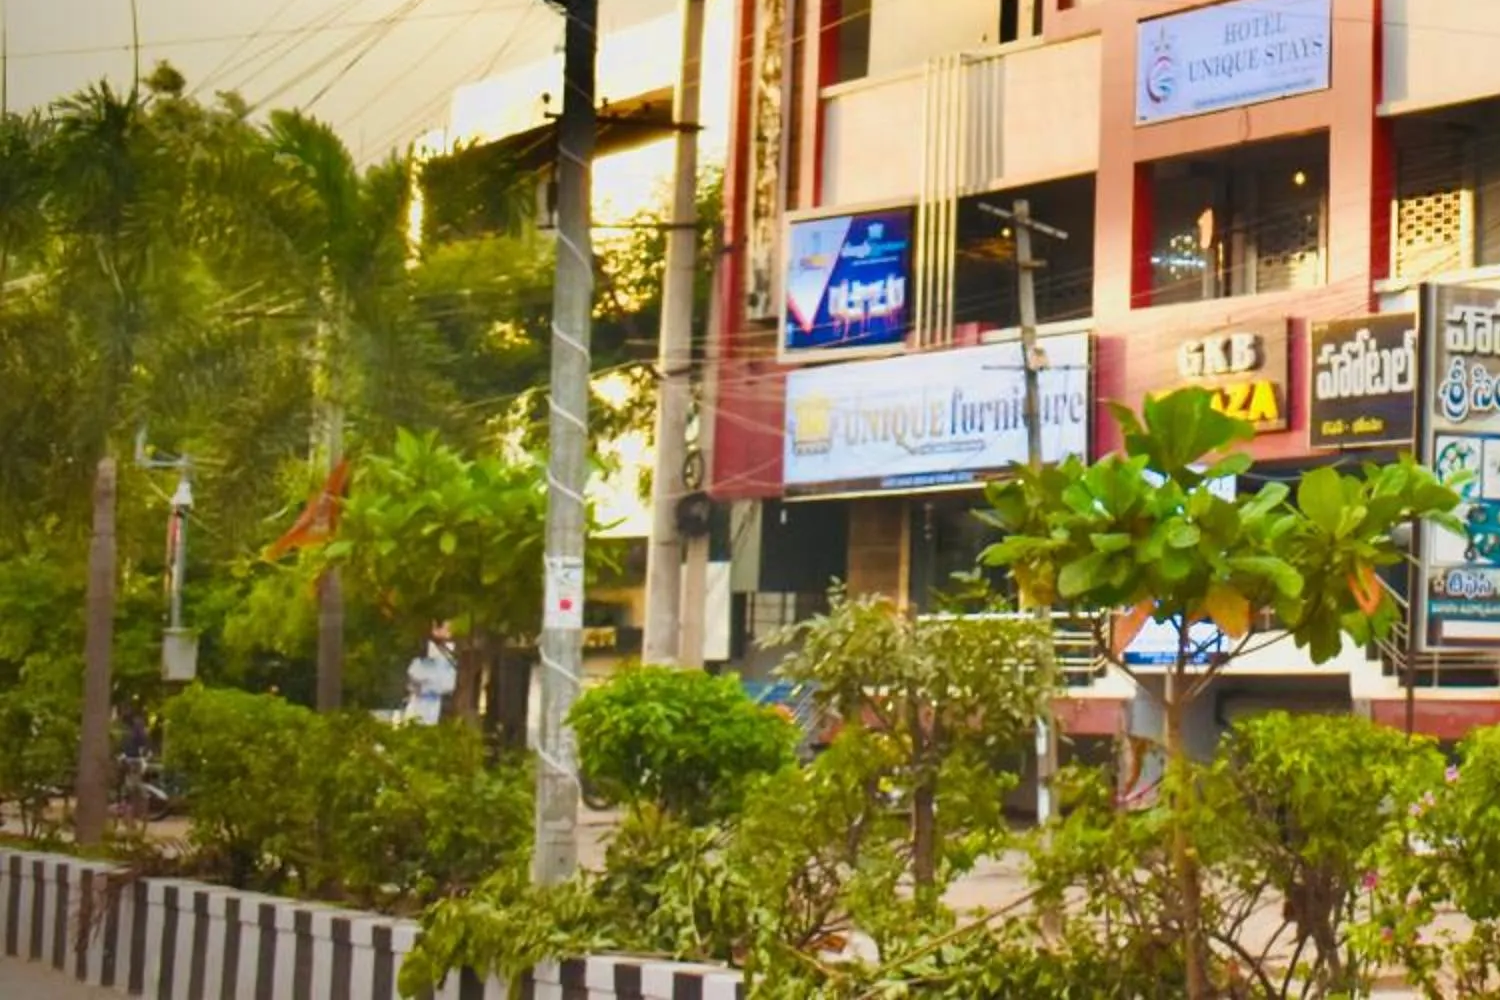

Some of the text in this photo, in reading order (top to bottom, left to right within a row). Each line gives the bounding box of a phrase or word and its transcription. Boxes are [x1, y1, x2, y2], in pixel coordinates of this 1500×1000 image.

[1224, 12, 1286, 46] HOTEL
[1189, 35, 1323, 84] UNIQUE STAYS
[1177, 331, 1258, 377] GKB
[842, 396, 945, 450] UNIQUE
